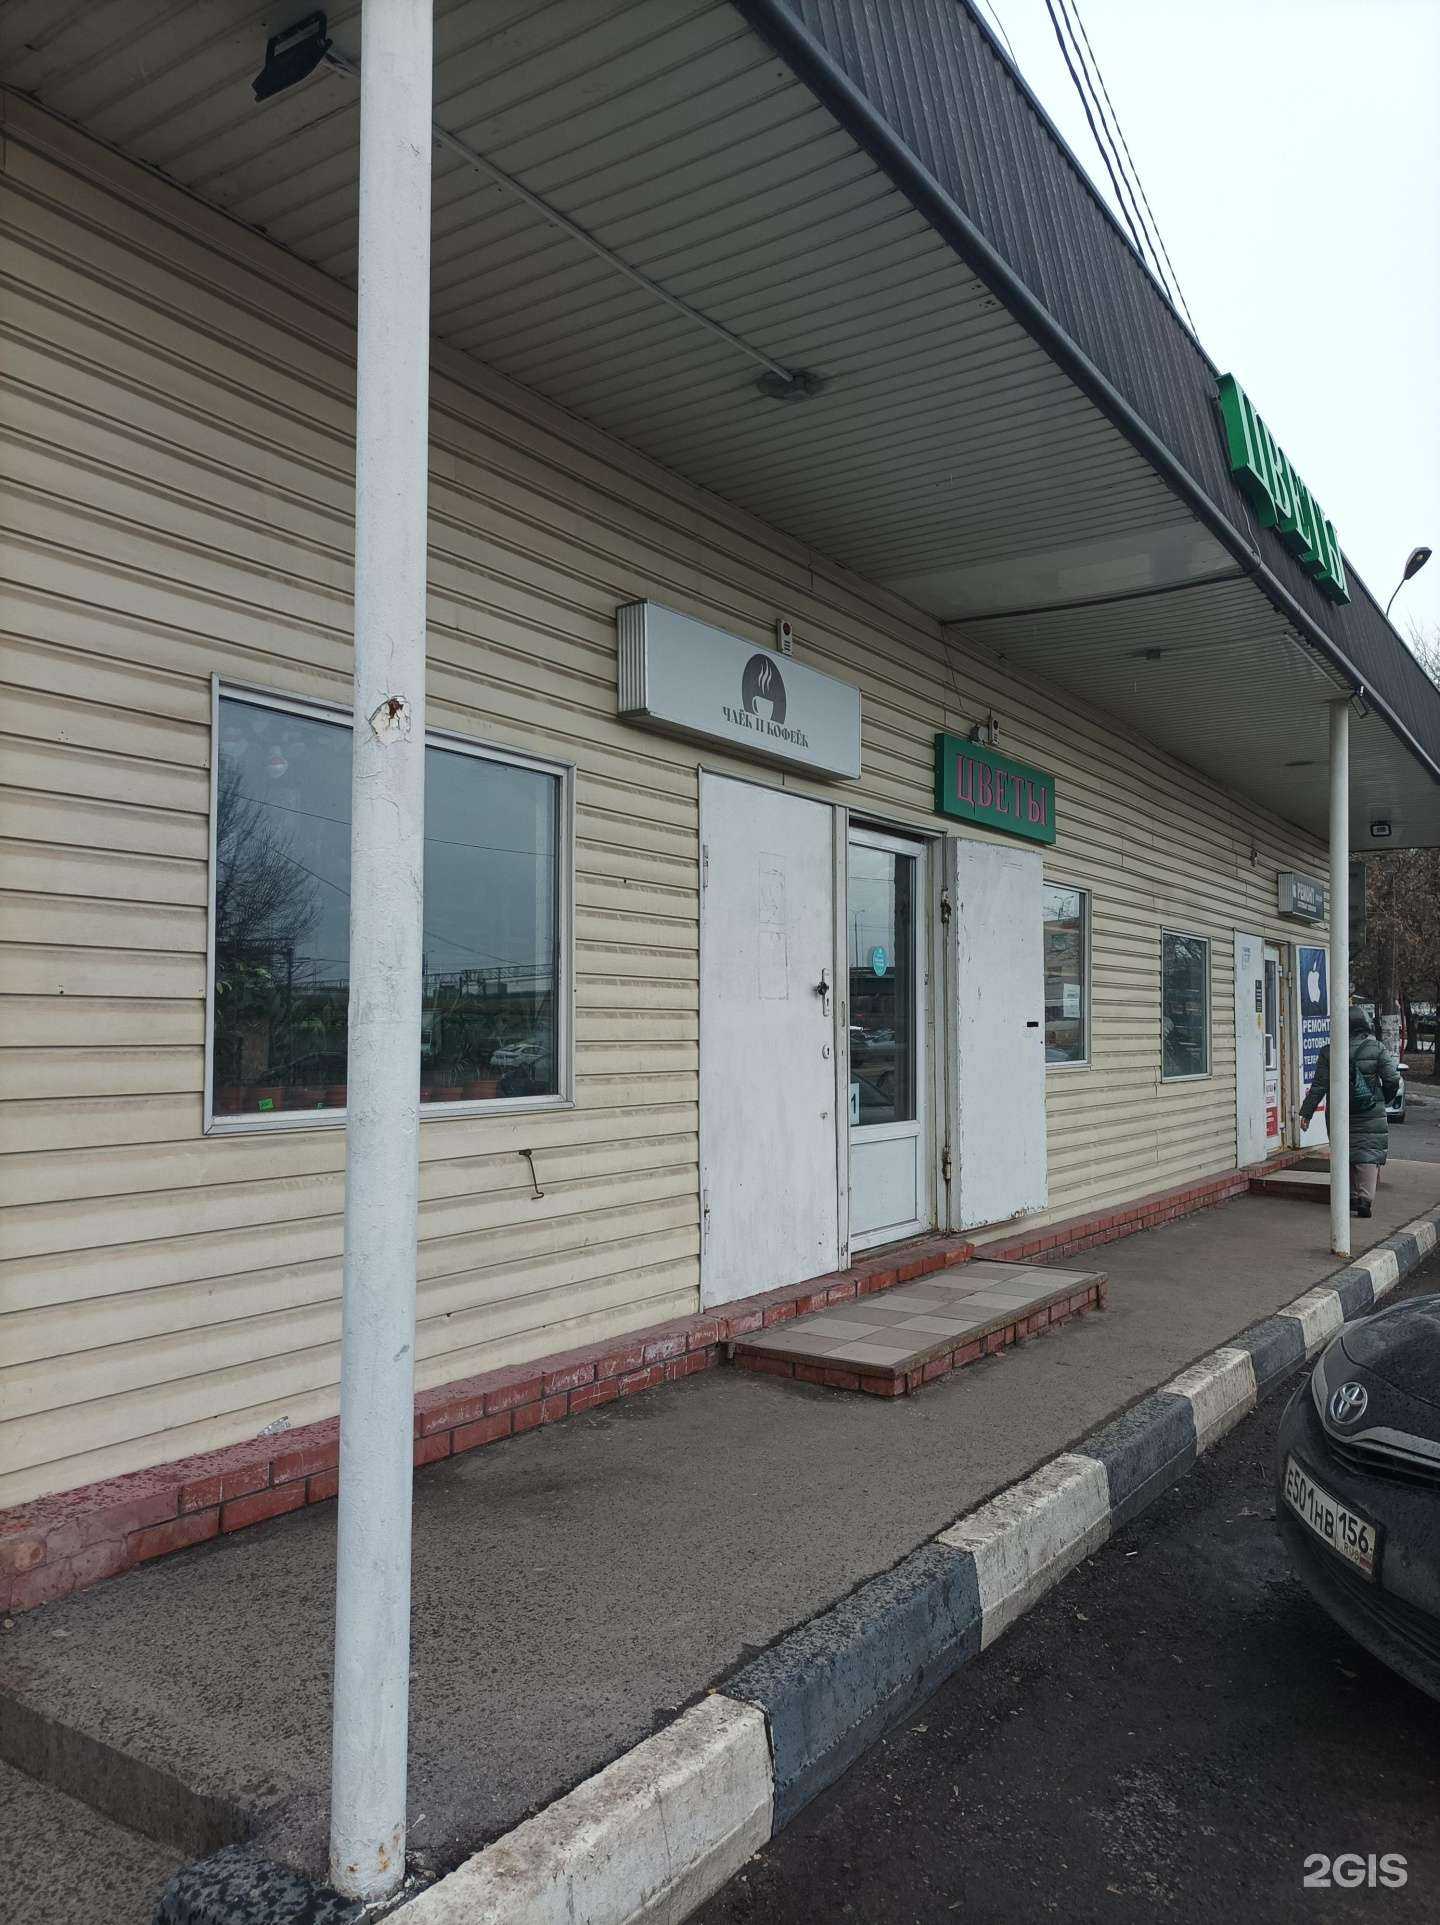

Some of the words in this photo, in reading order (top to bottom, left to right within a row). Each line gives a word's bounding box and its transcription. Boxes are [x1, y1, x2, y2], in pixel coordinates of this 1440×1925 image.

[722, 706, 753, 729] ЧАЁК
[956, 754, 1049, 827] ЦВЕТЫ
[1303, 1018, 1330, 1033] РЕМОНТ
[1339, 1512, 1369, 1553] 156
